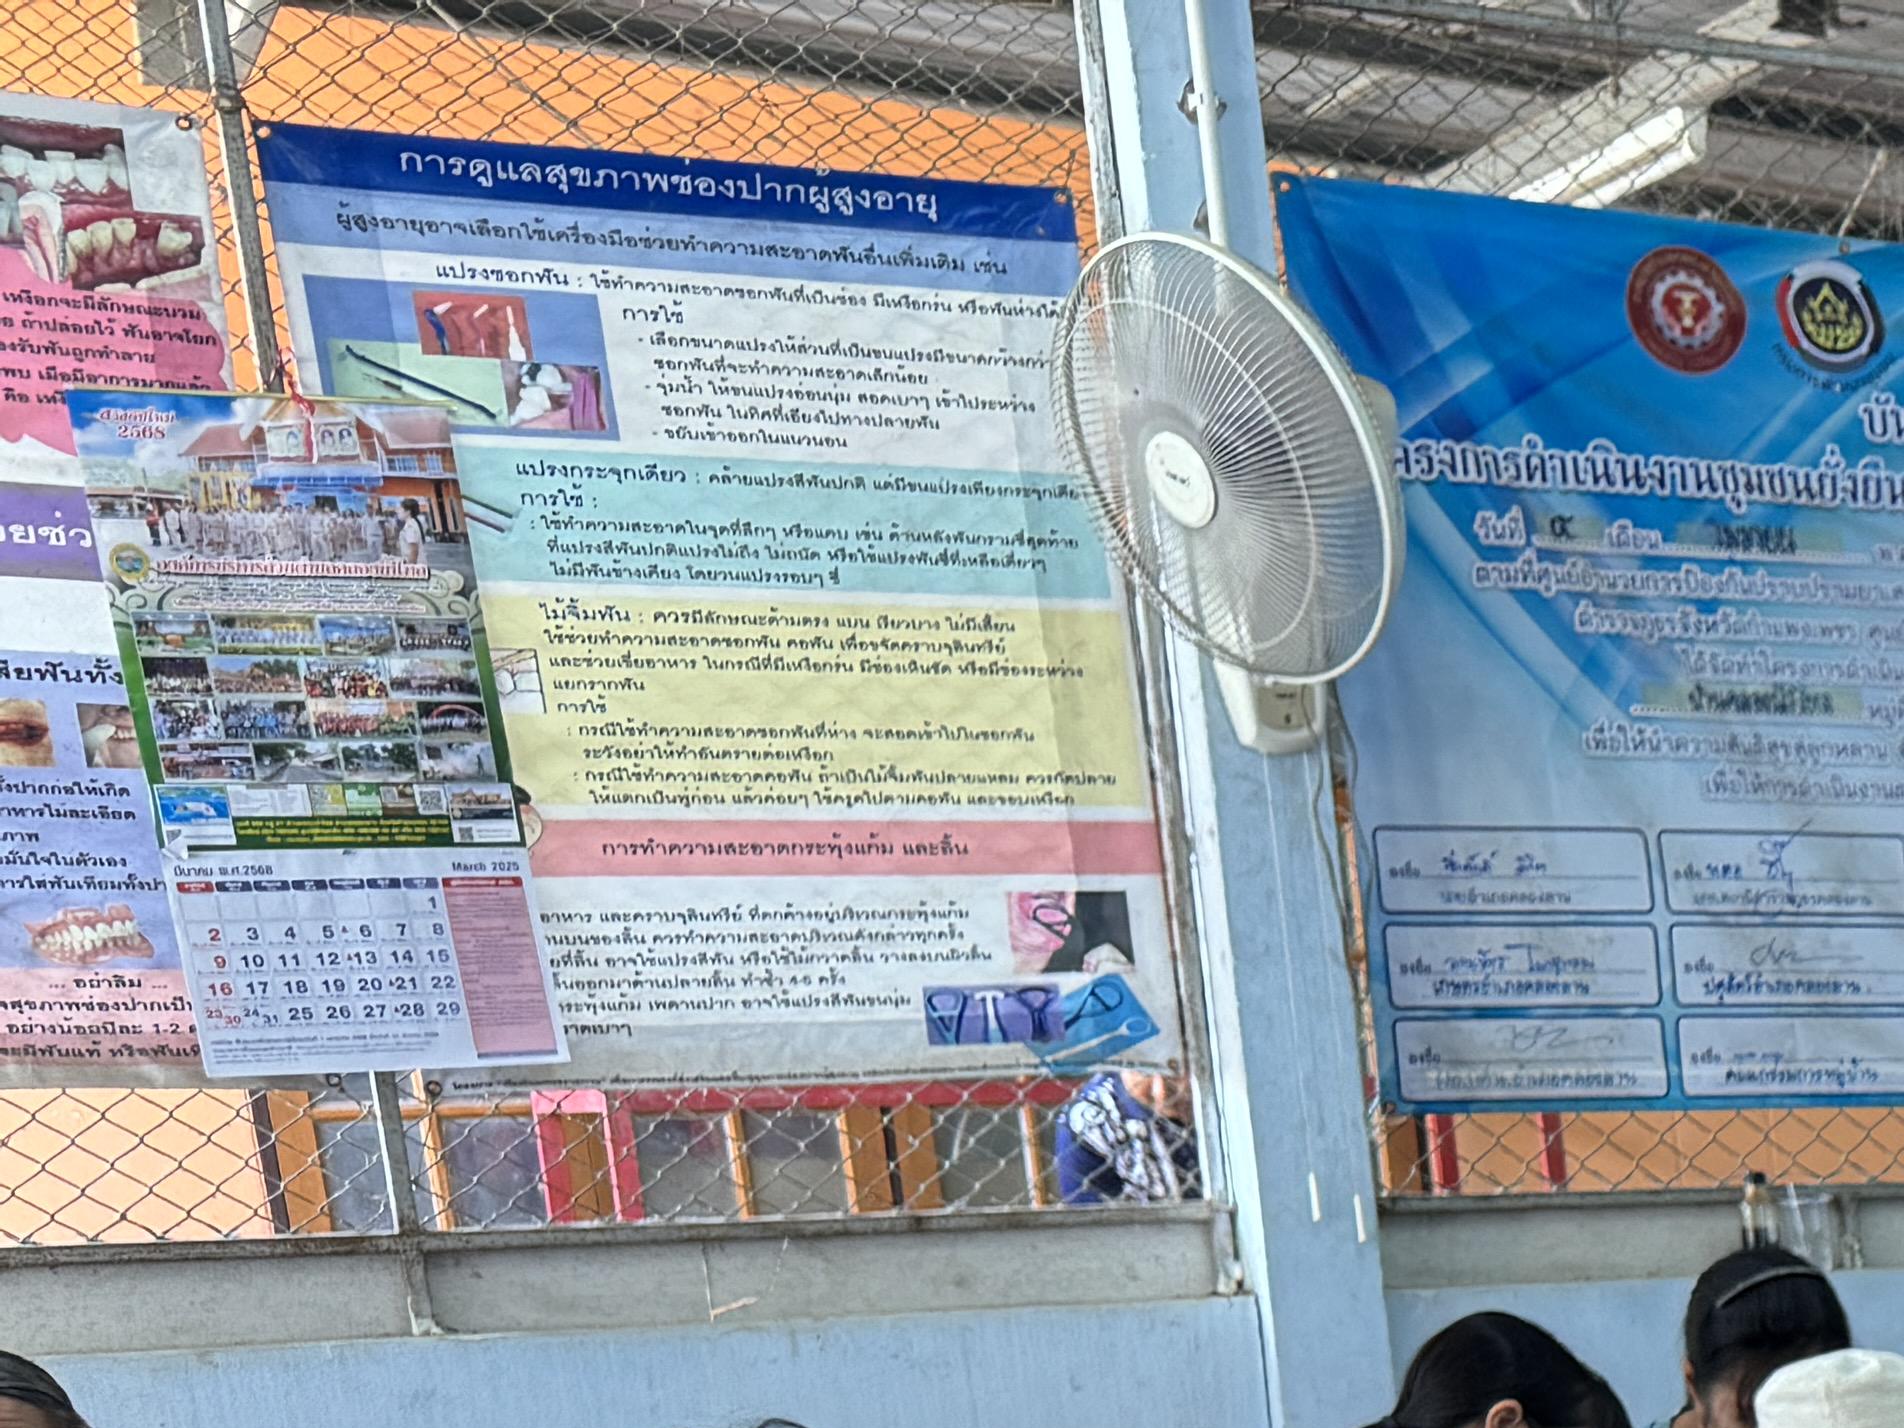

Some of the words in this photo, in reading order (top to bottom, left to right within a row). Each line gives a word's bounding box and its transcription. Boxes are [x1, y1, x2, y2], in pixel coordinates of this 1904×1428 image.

[623, 300, 684, 324] การใช้
[117, 424, 166, 440] 2568
[521, 483, 583, 507] การใช้
[557, 695, 607, 713] การใช้
[428, 896, 437, 910] 1
[208, 928, 221, 942] 2
[246, 927, 259, 940] 3
[284, 926, 296, 939] 4
[322, 925, 334, 939] 5
[359, 924, 373, 937] 6
[396, 923, 407, 936] 7
[432, 923, 444, 936] 8
[213, 955, 226, 969] 9
[241, 954, 264, 968] 10
[278, 953, 300, 967] 11
[316, 952, 341, 966] 12
[354, 951, 377, 965] 13
[391, 950, 413, 963] 14
[427, 949, 449, 962] 15
[208, 982, 232, 996] 16
[246, 981, 268, 995] 17
[284, 980, 308, 994] 18
[322, 979, 345, 993] 19
[358, 978, 382, 991] 20
[395, 977, 417, 990] 21
[431, 976, 455, 989] 22
[289, 1007, 313, 1021] 25
[326, 1006, 351, 1020] 26
[363, 1004, 387, 1018] 27
[400, 1004, 425, 1017] 28
[436, 1002, 460, 1016] 29
